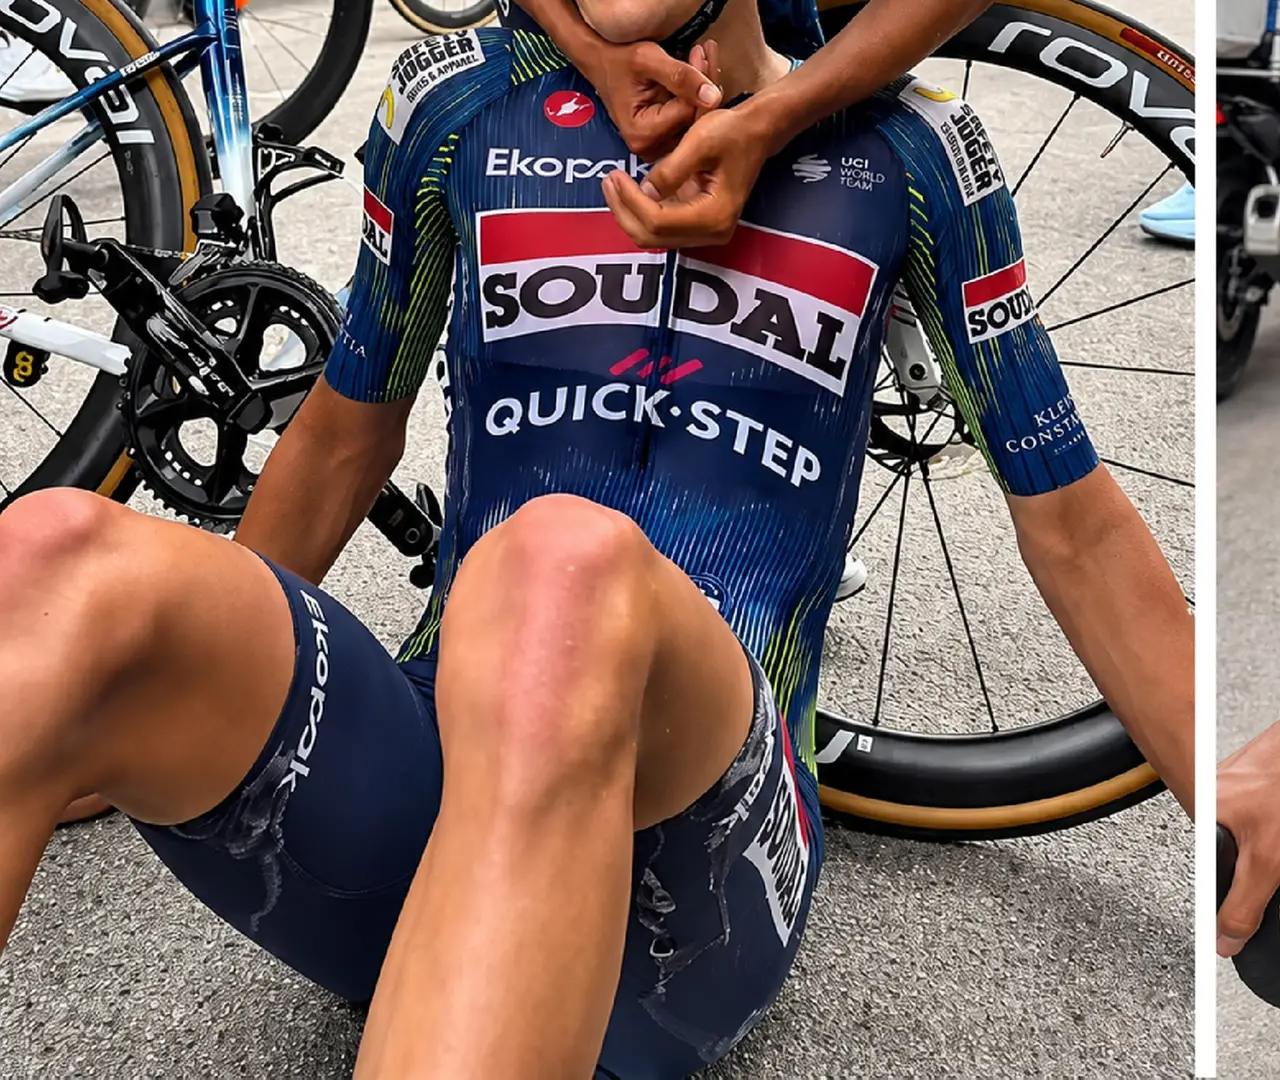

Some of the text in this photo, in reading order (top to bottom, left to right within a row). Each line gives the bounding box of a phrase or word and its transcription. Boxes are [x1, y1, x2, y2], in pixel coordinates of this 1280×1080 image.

[840, 167, 886, 186] WORLD
[841, 156, 870, 171] UCI
[482, 262, 848, 382] SOUDAL
[1006, 409, 1082, 454] CONSTA
